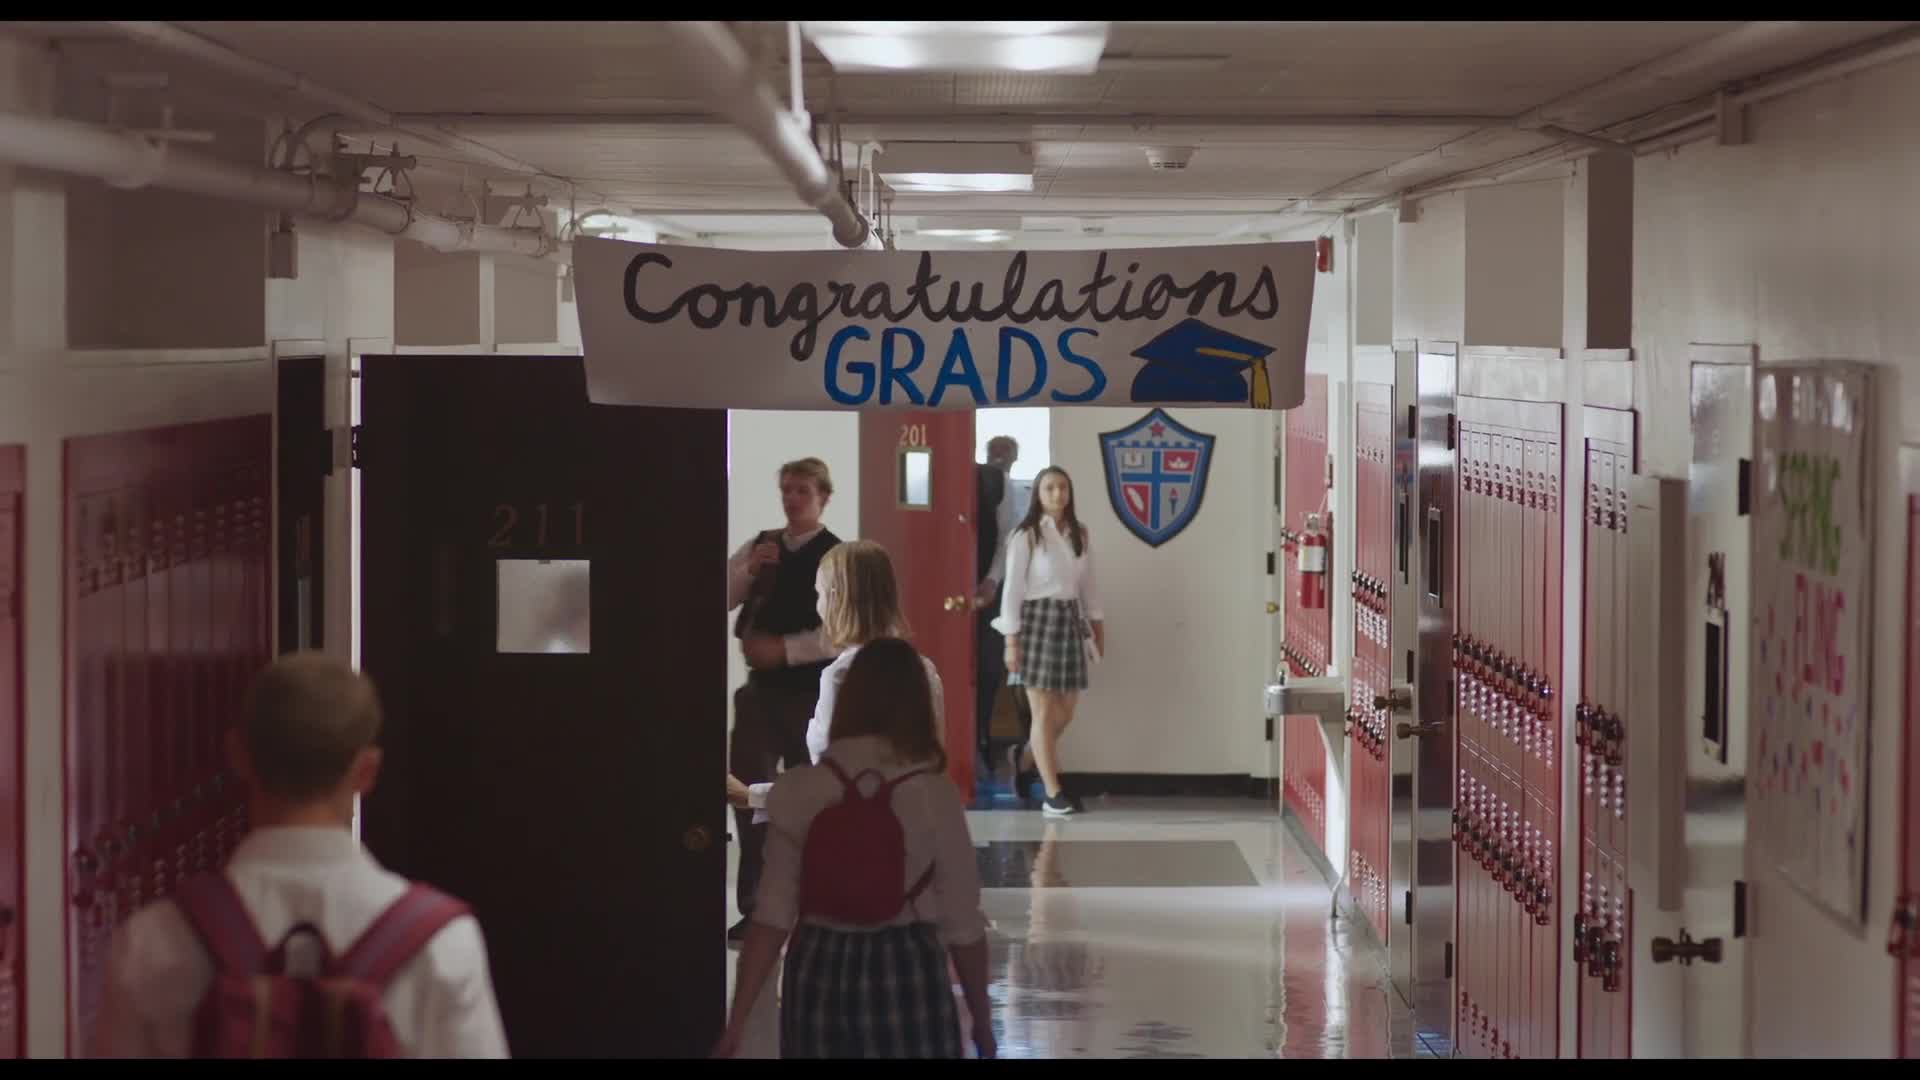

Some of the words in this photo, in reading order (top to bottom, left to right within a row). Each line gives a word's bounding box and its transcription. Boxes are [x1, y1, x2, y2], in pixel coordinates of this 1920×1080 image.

[622, 250, 1280, 361] Congratulations
[823, 324, 1108, 407] GRADS
[898, 423, 927, 447] 201
[487, 502, 585, 546] 211
